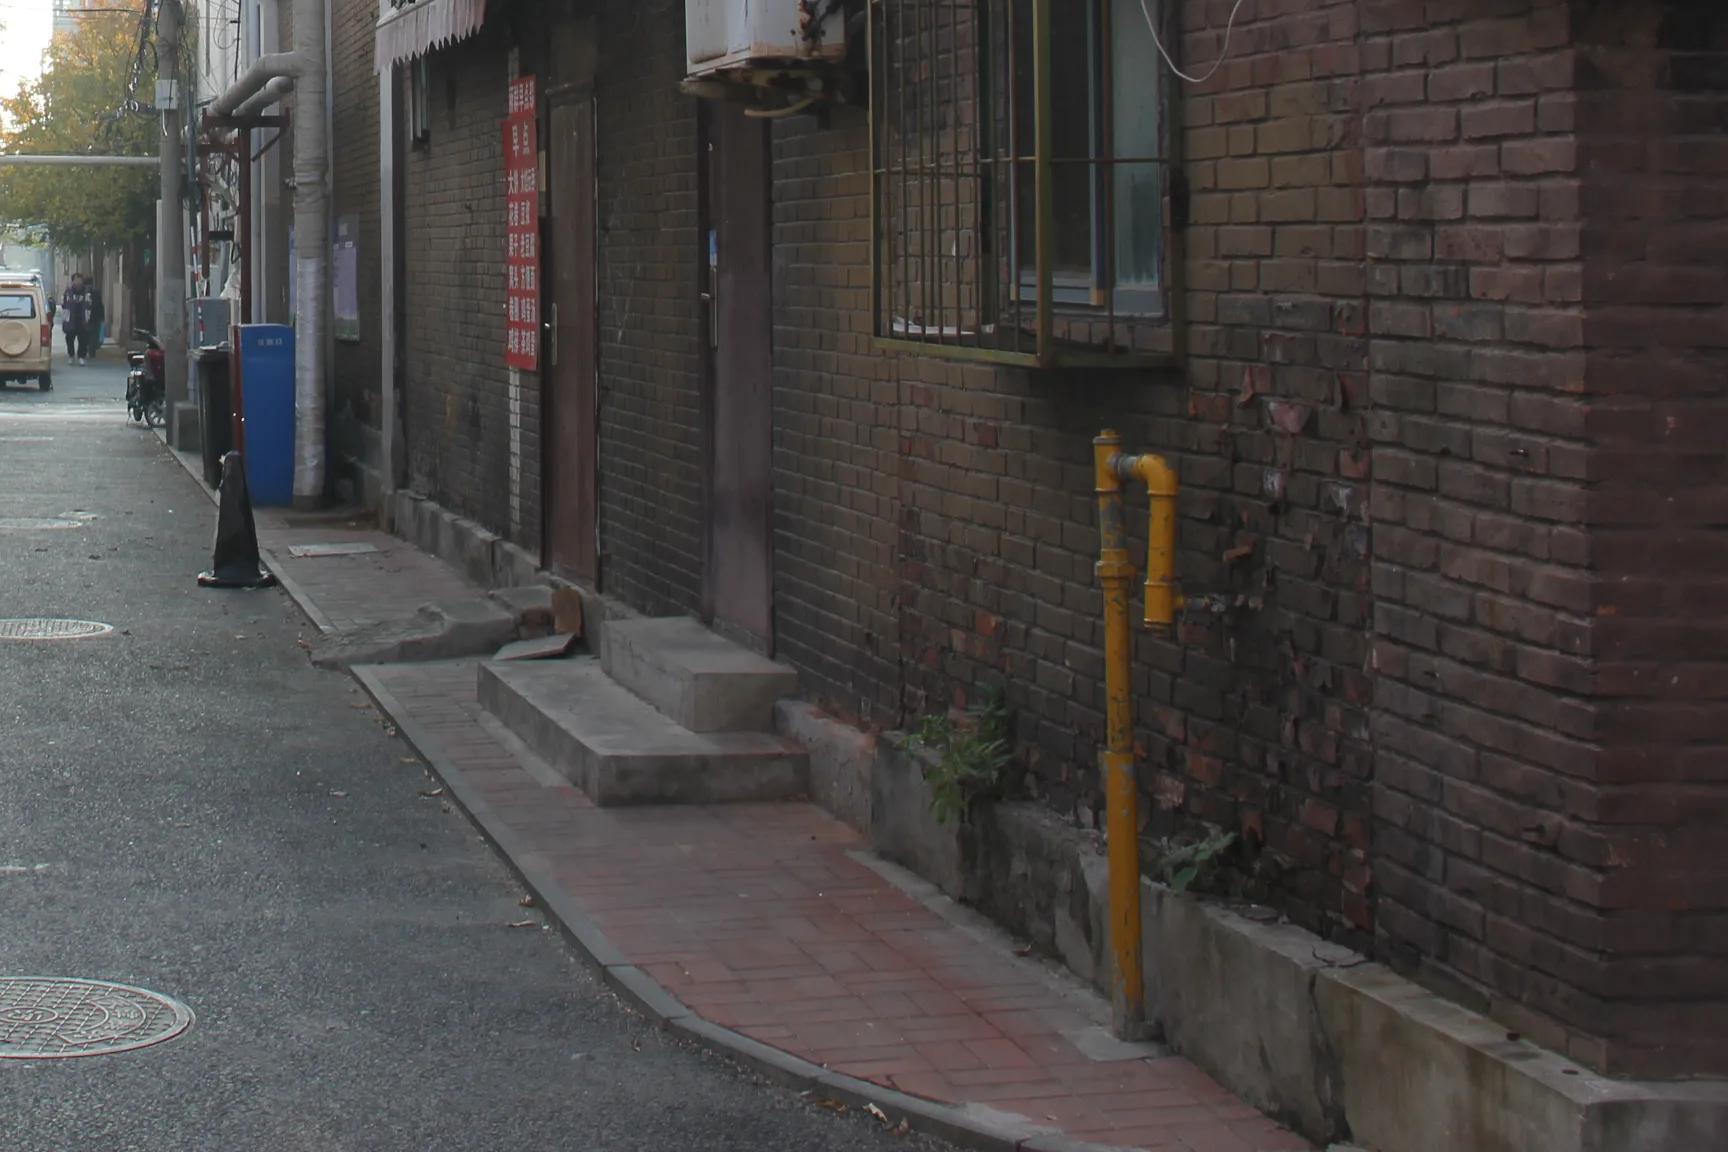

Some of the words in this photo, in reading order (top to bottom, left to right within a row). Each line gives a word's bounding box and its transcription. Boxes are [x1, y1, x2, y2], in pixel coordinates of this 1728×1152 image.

[512, 121, 530, 158] 早点
[520, 232, 535, 258] 老豆腐
[520, 263, 536, 291] 方便面
[520, 328, 535, 356] 茶鸡蛋
